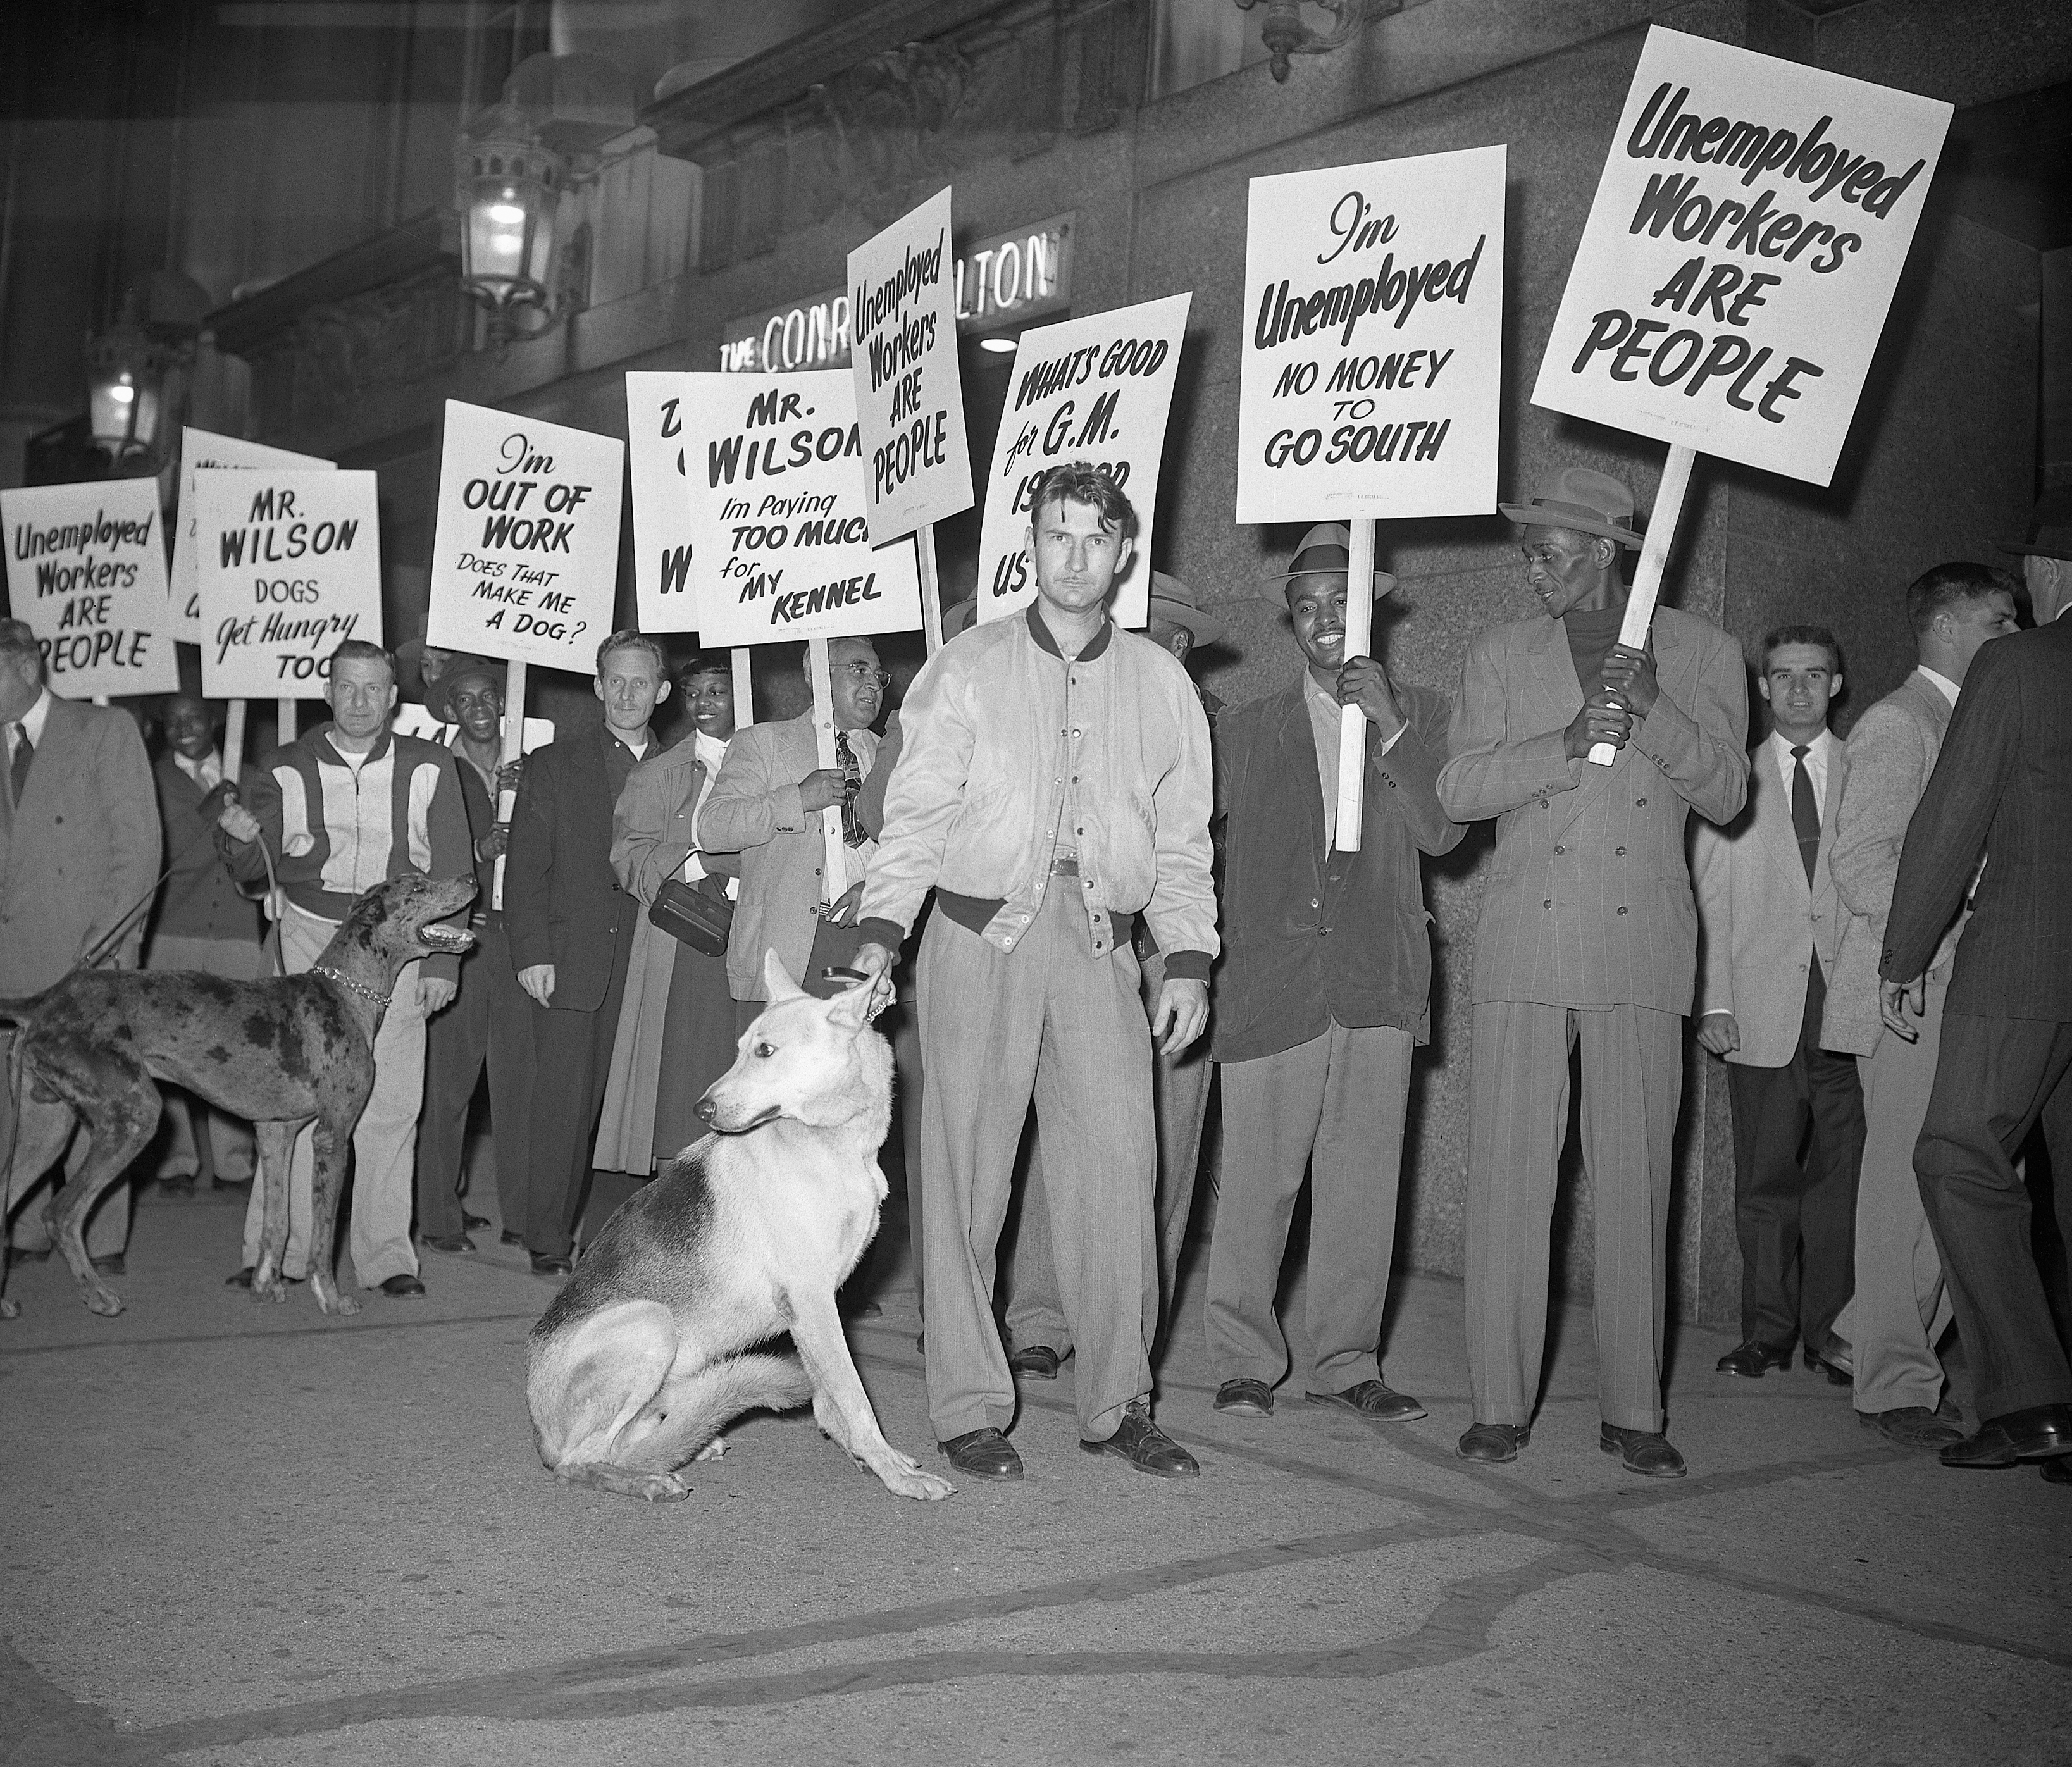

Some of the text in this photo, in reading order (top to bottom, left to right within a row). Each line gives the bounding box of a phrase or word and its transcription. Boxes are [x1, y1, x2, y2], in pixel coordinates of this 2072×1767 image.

[1627, 82, 1926, 220] Unemployed
[1317, 191, 1400, 264] I'm
[1628, 173, 1862, 273] Workers
[762, 296, 850, 373] CONR
[956, 232, 1048, 319] LTON
[855, 227, 945, 346] Unemployed
[1254, 233, 1486, 350] Unemployed
[1651, 256, 1782, 326] ARE
[869, 310, 937, 394] Workers
[1014, 338, 1169, 412] WHAT'S GOOD
[1272, 349, 1455, 398] NO MONEY
[1571, 309, 1825, 423] PEOPLE
[746, 388, 816, 430] MR.
[889, 366, 923, 428] ARE
[1333, 399, 1375, 421] TO
[496, 433, 555, 474] I'm
[872, 409, 948, 505] PEOPLE
[1003, 420, 1039, 477] for
[1043, 388, 1121, 456] G.M.
[1264, 418, 1451, 469] GO SOUTH
[248, 487, 304, 523] MR.
[462, 478, 592, 516] OUT OF
[719, 490, 838, 521] I'm Paying
[14, 509, 154, 562] Unemployed
[220, 519, 359, 569] WILSON
[481, 514, 575, 554] WORK
[731, 516, 869, 552] TOO MUC
[35, 554, 139, 599] Workers
[255, 578, 319, 604] DOGS
[456, 552, 560, 587] DOES THAT
[719, 556, 761, 579] for
[738, 568, 784, 604] MY
[57, 594, 112, 631] ARE
[471, 580, 576, 614] MAKE ME
[769, 572, 883, 625] KENNEL
[216, 611, 359, 665] Get Hungry
[485, 609, 587, 645] A DOG?
[276, 654, 332, 680] TOO
